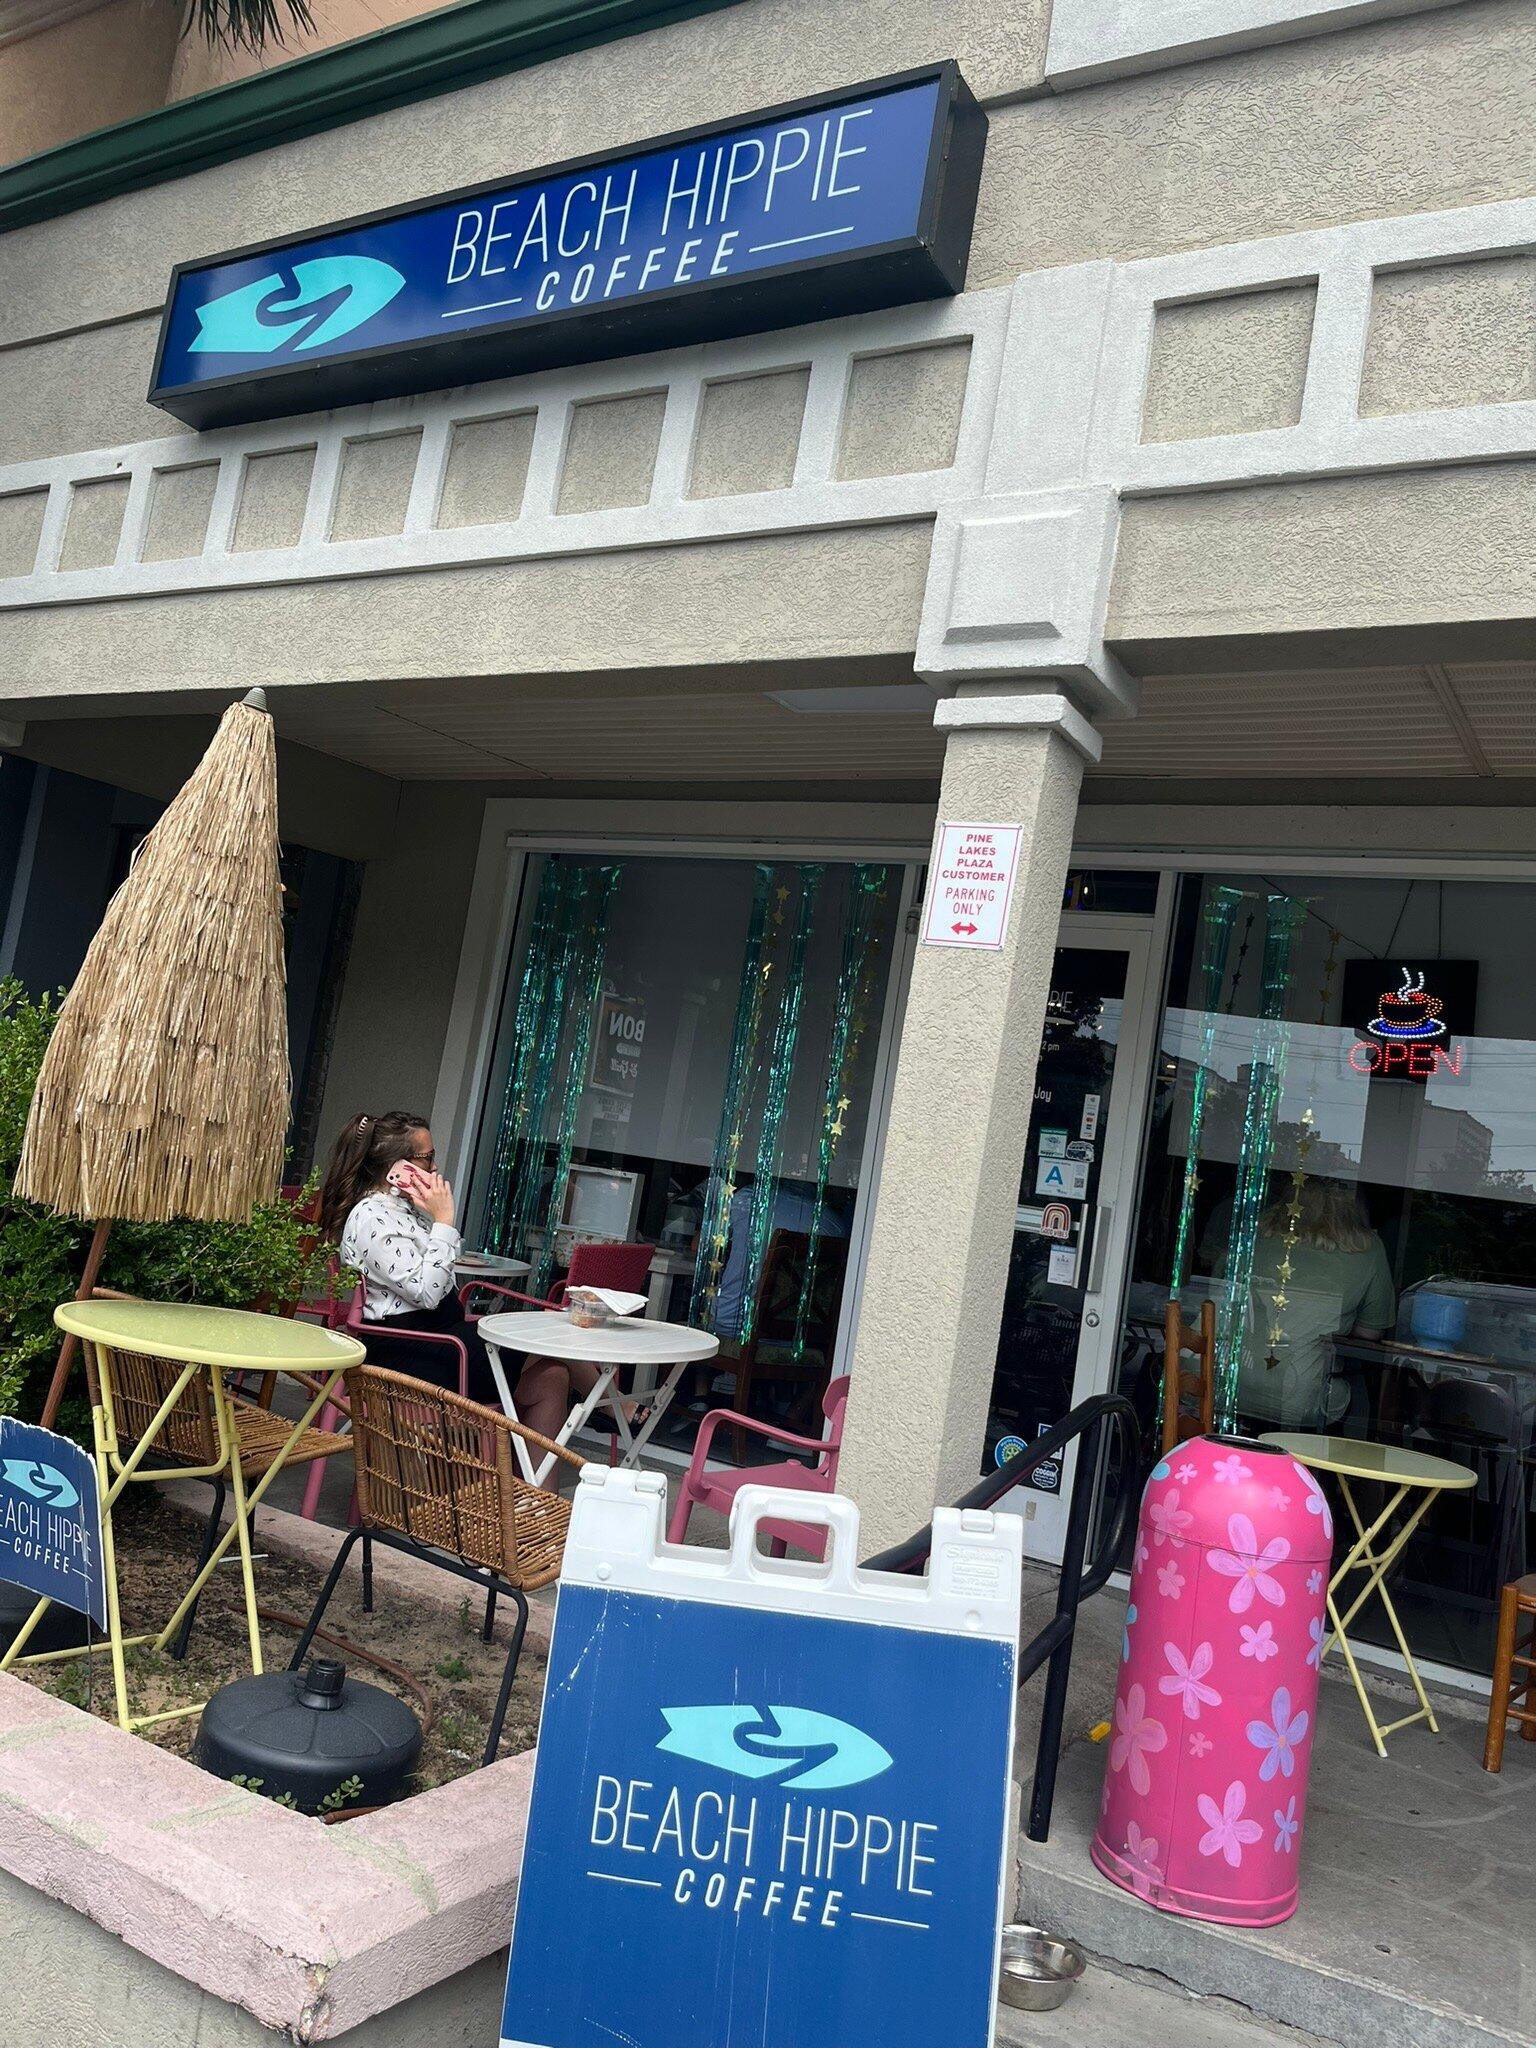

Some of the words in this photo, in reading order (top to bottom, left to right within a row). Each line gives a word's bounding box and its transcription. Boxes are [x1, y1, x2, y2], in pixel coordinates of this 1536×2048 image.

[447, 167, 638, 285] BEACH
[660, 109, 874, 236] HIPPIE
[536, 230, 740, 312] COFFEE
[966, 834, 993, 843] PINE
[959, 846, 996, 856] LAKES
[957, 858, 993, 868] PLAZA
[942, 870, 1005, 881] CUSTOMER
[945, 887, 996, 902] PARKING
[953, 902, 984, 916] ONLY
[1048, 990, 1074, 1013] PIE
[1348, 1041, 1461, 1077] OPEN
[1034, 1086, 1052, 1102] Joy
[1045, 1166, 1063, 1185] A
[0, 1494, 40, 1540] ACH
[14, 1536, 70, 1574] COFFEE
[590, 1774, 757, 1867] BEACH
[779, 1802, 938, 1896] HIPPIE
[673, 1868, 843, 1926] COFFEE
